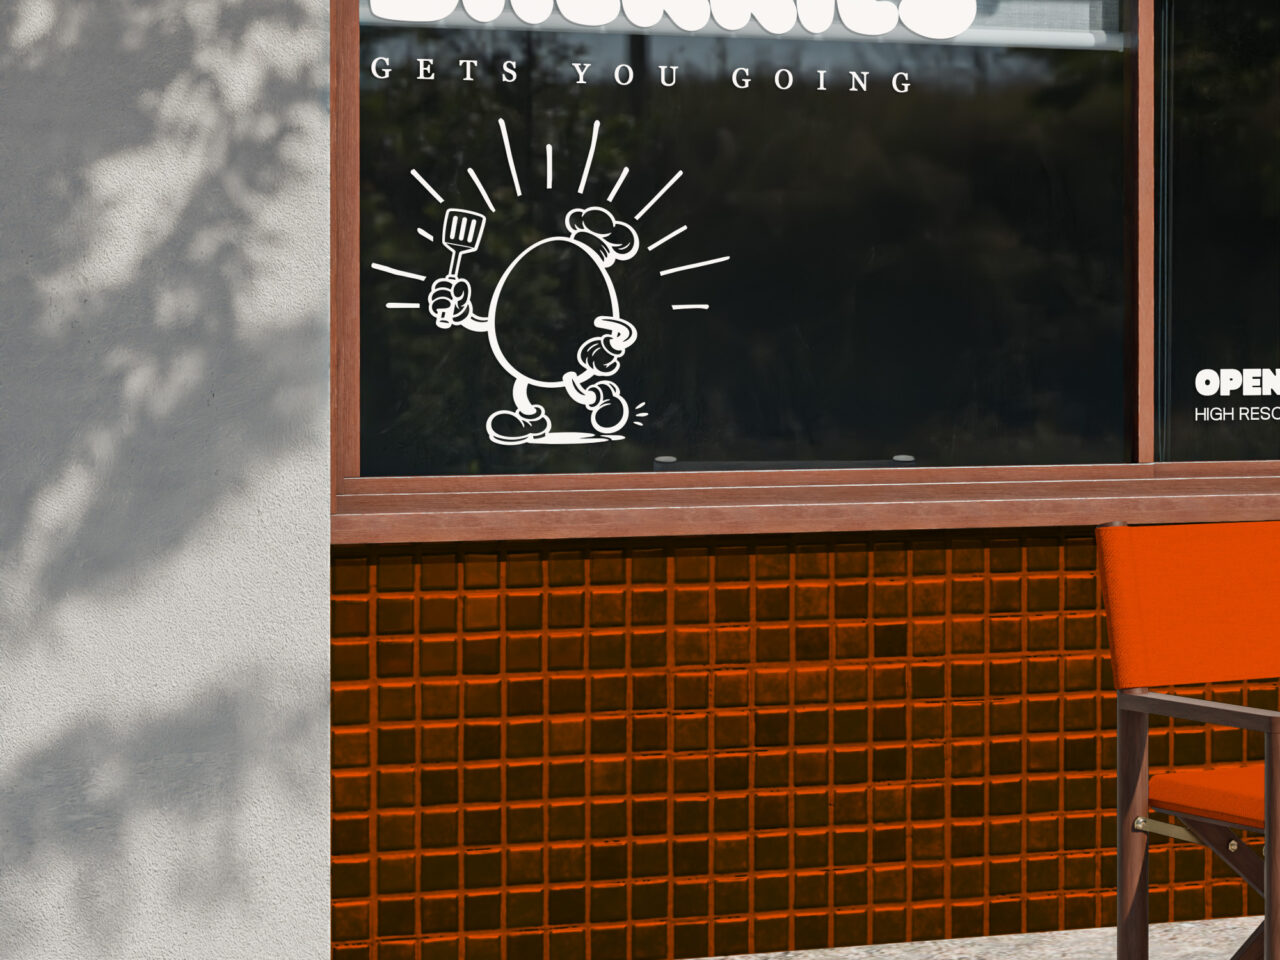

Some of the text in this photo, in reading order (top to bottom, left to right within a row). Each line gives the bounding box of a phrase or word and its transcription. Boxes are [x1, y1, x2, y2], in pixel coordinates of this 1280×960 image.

[371, 57, 911, 93] GETS YOU GOING
[1195, 407, 1234, 421] HIGH
